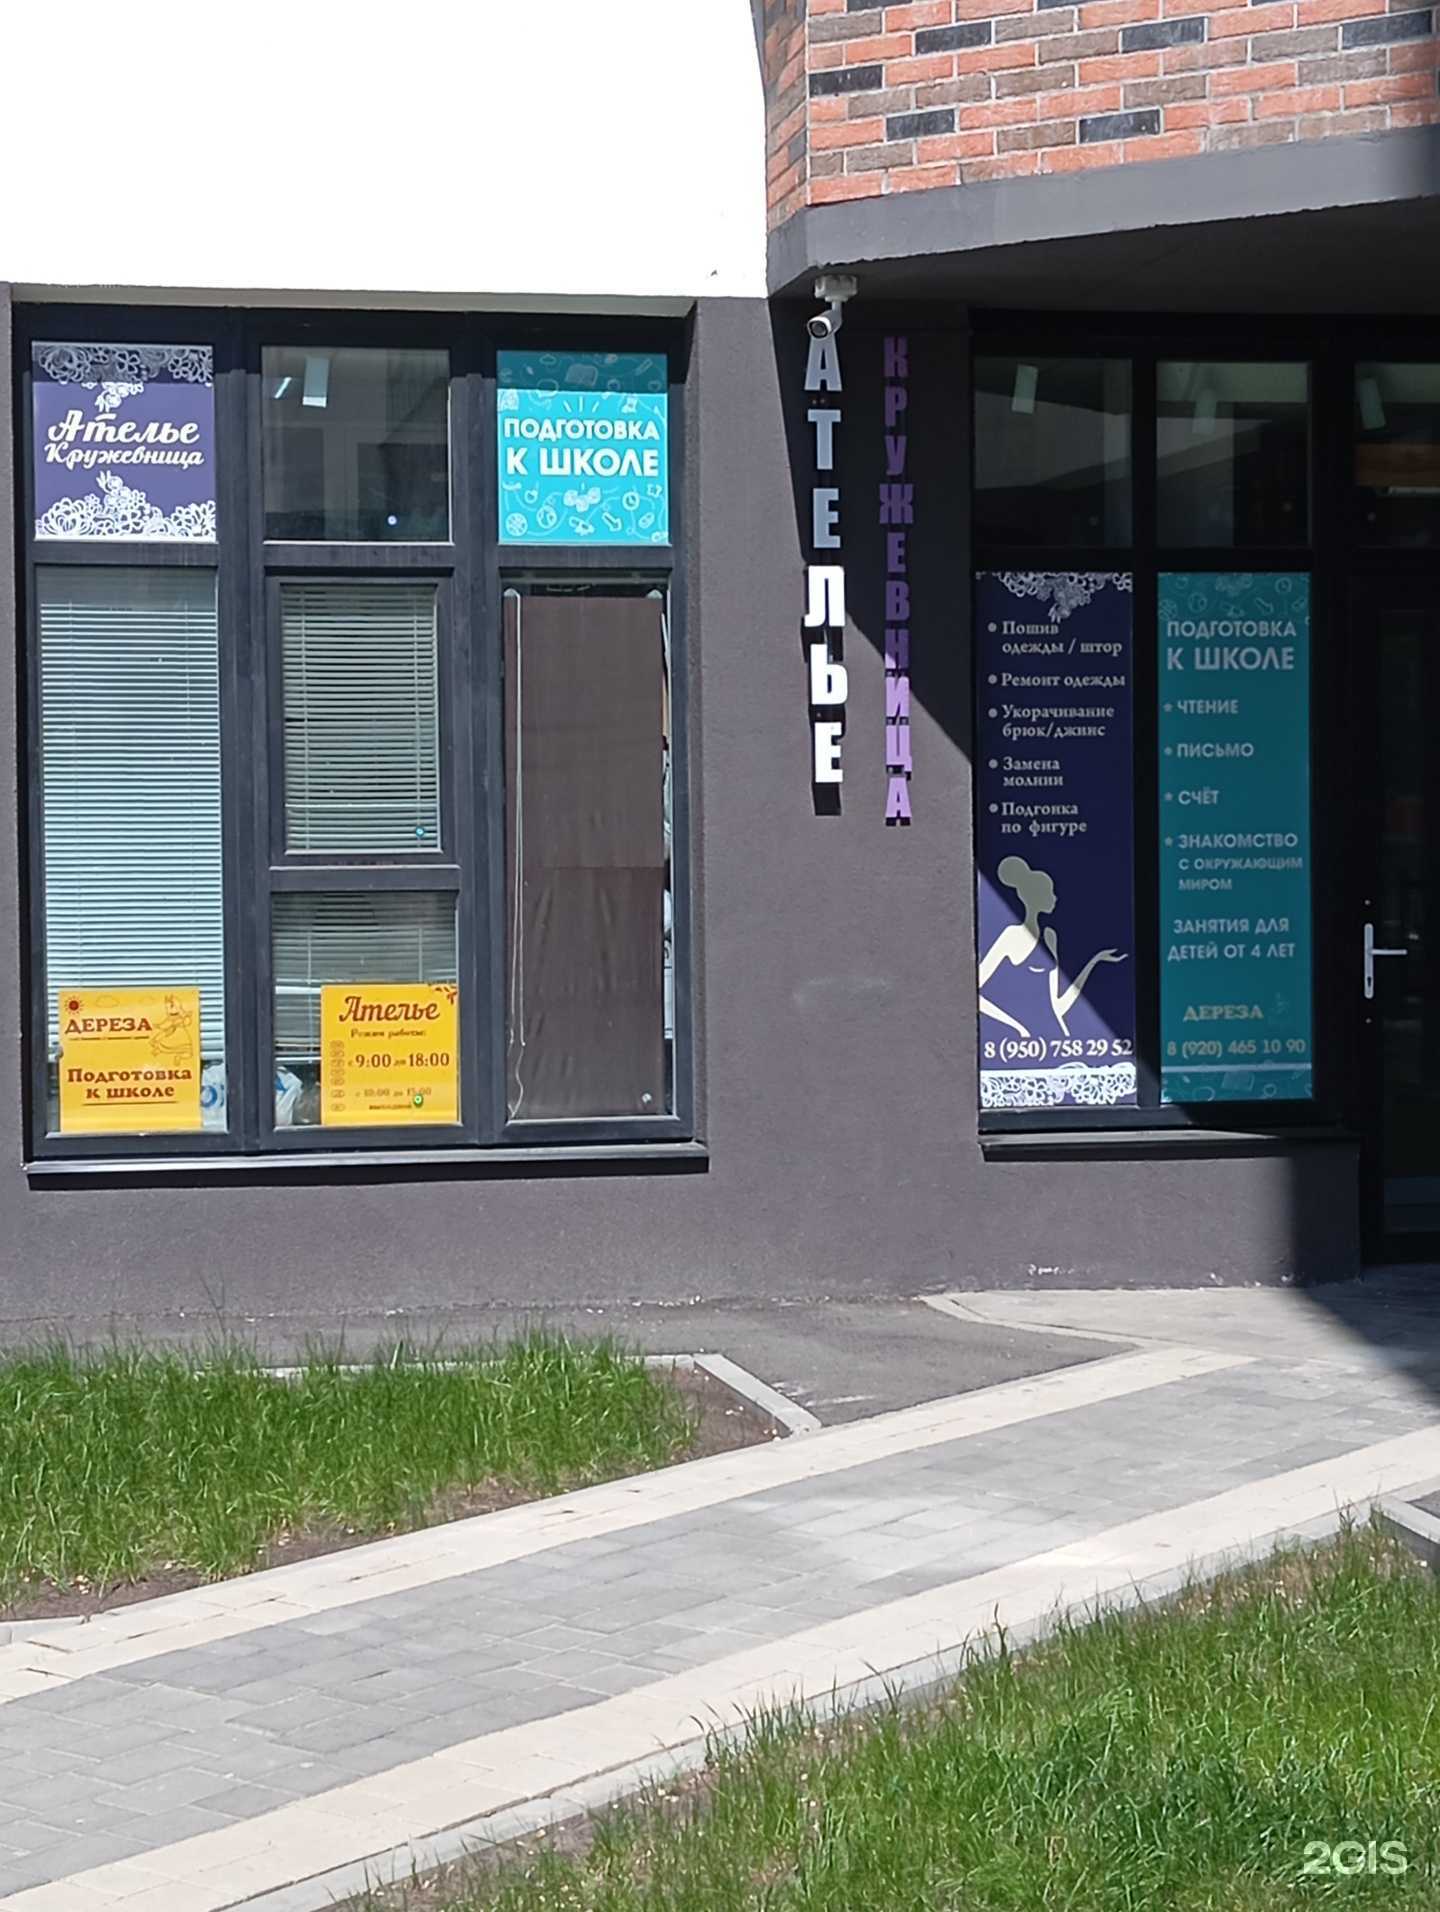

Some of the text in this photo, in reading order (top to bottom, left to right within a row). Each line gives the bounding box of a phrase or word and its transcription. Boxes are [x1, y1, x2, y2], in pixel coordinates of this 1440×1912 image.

[47, 409, 200, 444] Ателье
[504, 417, 660, 442] ПОДГОТОВКА
[44, 442, 204, 470] Кружевница
[507, 448, 659, 477] К ШКОЛЕ
[804, 336, 848, 783] АТЕЛЬЕ
[879, 336, 914, 818] КРУЖЕВНИЦА
[1002, 621, 1060, 635] Пошив
[1167, 620, 1297, 640] ПОДГОТОВКА
[1002, 642, 1064, 655] одежды
[1080, 642, 1122, 657] штор
[1167, 647, 1294, 670] К ШКОЛЕ
[1001, 673, 1125, 688] Ремонт одежды
[1002, 704, 1115, 722] Укорачивание
[1177, 700, 1239, 714] ЧТЕНИЕ
[1002, 721, 1106, 741] брюк/джинс
[1177, 743, 1254, 757] ПИСЬМО
[1003, 756, 1060, 770] Замена
[1003, 776, 1064, 786] молнии
[1178, 786, 1219, 805] СЧЁТ
[1001, 802, 1079, 817] Подгонка
[1001, 819, 1087, 837] по фигуре
[1178, 833, 1298, 848] ЗНАКОМСТВО
[1178, 857, 1303, 870] С ОКРУЖАЮЩИМ
[1178, 879, 1232, 890] МИРОМ
[1173, 917, 1289, 934] ЗАНЯТИЯ ДЛЯ
[1167, 941, 1296, 962] ДЕТЕЙ ОТ 4 ЛЕТ
[339, 995, 441, 1022] Ателье
[1183, 1005, 1264, 1021] ДЕРЕЗА
[65, 1017, 152, 1034] ДЕРЕЗА
[984, 1037, 1132, 1063] 8 (950) 758 29 52
[1168, 1039, 1306, 1059] 8 (920) 465 10 90
[355, 1054, 392, 1067] 9:00
[409, 1053, 450, 1067] 18:00
[67, 1069, 192, 1083] Подготовка
[86, 1086, 175, 1099] к школе
